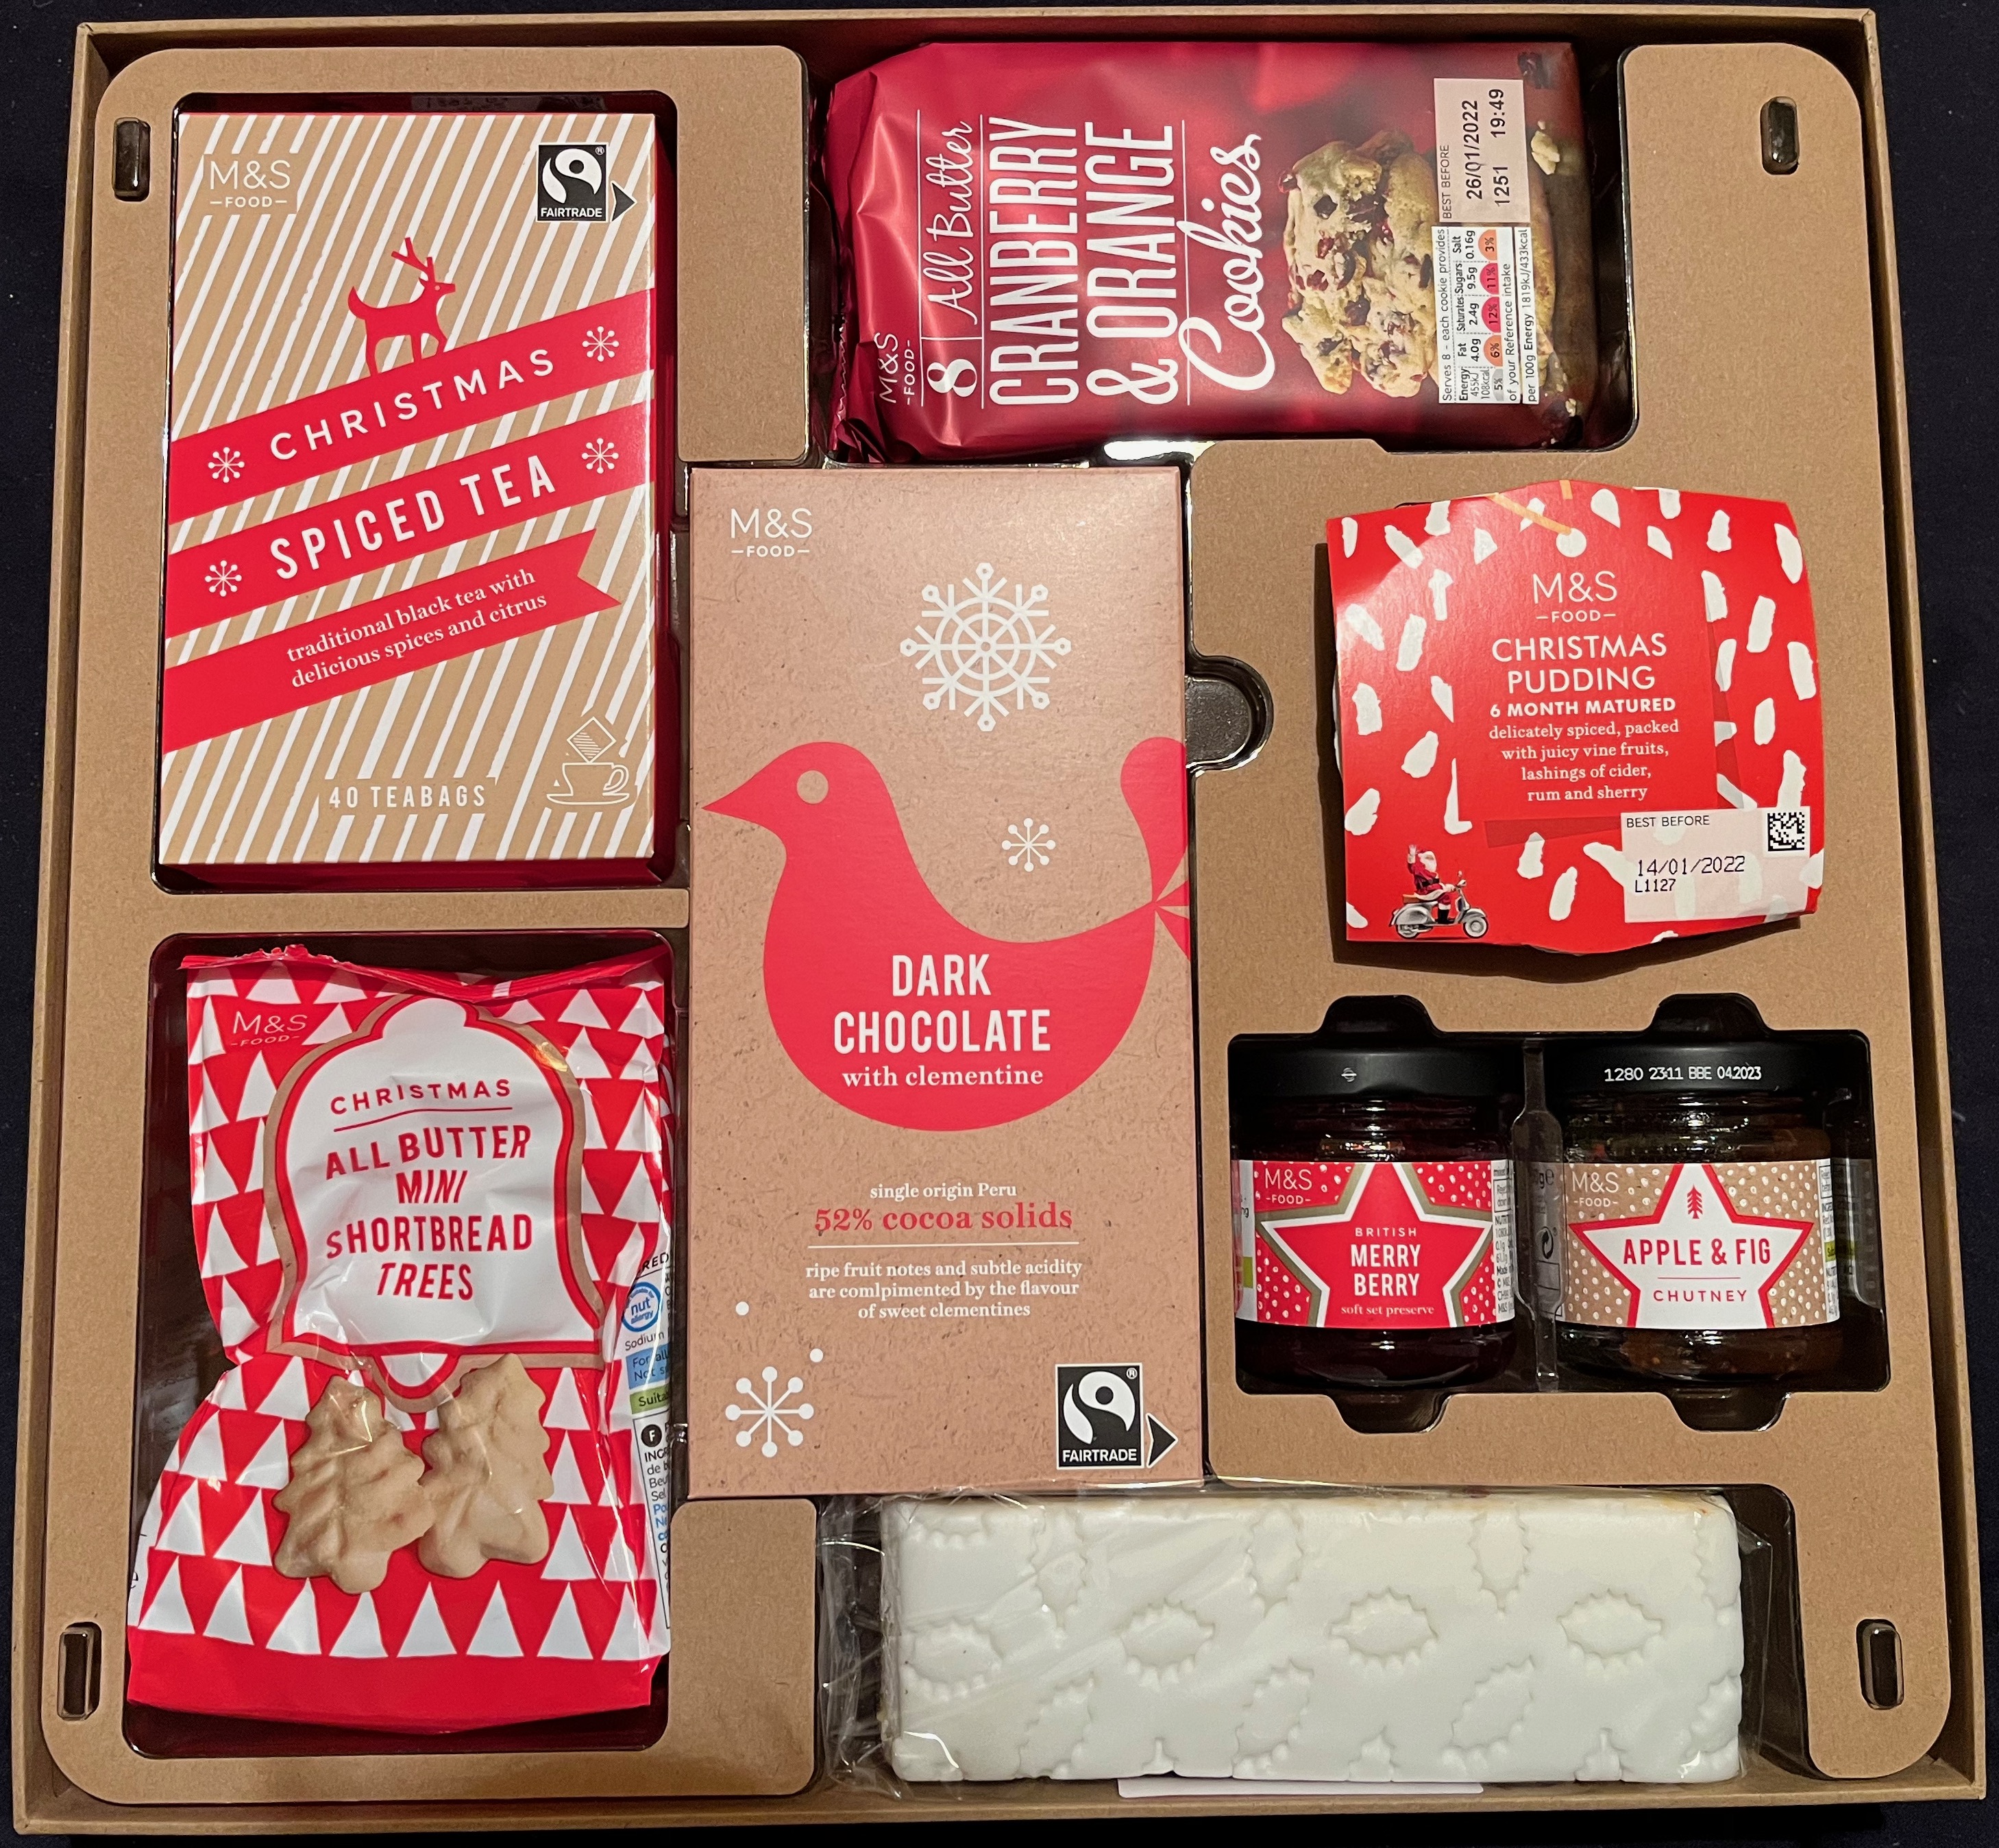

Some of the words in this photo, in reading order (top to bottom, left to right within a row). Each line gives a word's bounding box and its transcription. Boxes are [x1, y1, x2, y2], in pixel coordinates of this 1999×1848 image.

[1488, 88, 1506, 138] 19:49
[1462, 100, 1482, 199] 26/01/2022
[210, 159, 291, 190] M&S
[1440, 145, 1451, 188] BEFORE
[925, 121, 973, 241] Butter
[1493, 167, 1510, 207] 1251
[541, 207, 602, 218] FAIRTRADE
[1442, 193, 1451, 219] BEST
[1085, 121, 1177, 338] ORANGE
[1436, 229, 1449, 273] provides
[1451, 236, 1462, 254] Salt
[1464, 230, 1475, 259] 0.16g
[1484, 237, 1495, 252] 3%
[989, 116, 1079, 405] CRANBERRY
[1176, 134, 1276, 390] Cookies
[1517, 229, 1532, 308] 1819kJ/433kcal
[923, 246, 977, 325] All
[1454, 263, 1465, 294] Sugars
[1467, 267, 1477, 290] 9.5g
[1486, 267, 1496, 288] 11%
[1501, 263, 1512, 297] intake
[1438, 278, 1449, 312] cookie
[1456, 297, 1465, 332] Saturates
[1469, 303, 1479, 325] 2.4g
[1488, 304, 1499, 325] 12%
[1439, 315, 1450, 341] each
[1504, 300, 1515, 356] Reference
[1523, 313, 1534, 350] Energy
[1458, 343, 1467, 357] Fat
[1471, 338, 1481, 362] 4.0g
[1490, 343, 1500, 358] 6%
[879, 332, 898, 404] M&S
[927, 358, 978, 397] 8
[1509, 359, 1519, 386] your
[1525, 355, 1536, 380] 100g
[1086, 358, 1178, 405] &
[1443, 365, 1452, 402] Serves
[1459, 368, 1471, 401] Energy
[1470, 372, 1479, 397] 455kJ
[1480, 369, 1491, 399] 108kcal
[1494, 378, 1504, 391] 5%
[1527, 384, 1537, 403] per
[271, 349, 554, 460] CHRISTMAS
[1507, 389, 1517, 402] of
[270, 489, 445, 580] SPICED
[461, 455, 556, 516] TEA
[730, 508, 813, 539] M&S
[1532, 570, 1617, 604] M&S
[286, 613, 394, 661] traditional
[395, 596, 452, 625] black
[455, 586, 487, 607] tea
[489, 568, 536, 595] with
[291, 647, 381, 688] delicious
[385, 626, 444, 660] spices
[449, 611, 487, 637] and
[489, 593, 548, 623] citrus
[1491, 632, 1667, 663] CHRISTMAS
[1508, 665, 1656, 694] PUDDING
[1490, 704, 1501, 718] 6
[1507, 701, 1578, 717] MONTH
[1585, 698, 1676, 715] MATURED
[1489, 724, 1562, 740] delicately
[1567, 722, 1621, 739] spiced,
[1625, 719, 1680, 737] packed
[1501, 746, 1537, 760] with
[1540, 745, 1579, 762] juicy
[1582, 743, 1617, 757] vine
[1620, 743, 1669, 758] fruits,
[1521, 766, 1586, 782] lashings
[1590, 764, 1606, 778] of
[1609, 764, 1652, 778] cider,
[329, 787, 358, 809] 40
[371, 785, 485, 808] TEABAGS
[1528, 790, 1560, 802] rum
[1565, 786, 1593, 800] and
[1597, 785, 1648, 801] sherry
[1626, 817, 1656, 828] BEST
[1661, 815, 1710, 827] BEFORE
[1638, 855, 1745, 877] 14/01/2022
[1634, 878, 1676, 893] L1127
[892, 954, 991, 997] DARK
[233, 1011, 308, 1035] M&S
[834, 1009, 1050, 1054] CHOCOLATE
[842, 1065, 898, 1087] with
[905, 1065, 1044, 1085] clementine
[1604, 1067, 1643, 1081] 1280
[1688, 1066, 1713, 1080] BBE
[330, 1079, 511, 1115] CHRISTMAS
[326, 1139, 389, 1179] ALL
[400, 1124, 531, 1165] BUTTER
[395, 1169, 467, 1204] MINI
[870, 1183, 919, 1202] single
[922, 1183, 973, 1201] origin
[978, 1183, 1017, 1196] Peru
[1264, 1169, 1313, 1190] M&S
[1573, 1172, 1619, 1193] M&S
[814, 1208, 872, 1231] 52%
[883, 1211, 972, 1230] cocoa
[981, 1201, 1072, 1229] solids
[326, 1213, 532, 1259] SHORTBREAD
[1355, 1227, 1417, 1237] BRITISH
[641, 1252, 670, 1271] RED
[1350, 1243, 1421, 1268] MERRY
[1623, 1239, 1701, 1266] APPLE
[1711, 1237, 1728, 1266] &
[1736, 1239, 1771, 1265] FIG
[376, 1264, 474, 1301] TREES
[805, 1263, 839, 1281] ripe
[844, 1261, 882, 1277] fruit
[885, 1261, 931, 1277] notes
[935, 1260, 966, 1275] and
[970, 1259, 1021, 1275] subtle
[1025, 1259, 1083, 1277] acidity
[809, 1286, 835, 1299] are
[839, 1282, 961, 1301] comlpimented
[965, 1281, 985, 1301] by
[989, 1281, 1016, 1296] the
[1020, 1280, 1079, 1295] flavour
[1354, 1273, 1421, 1297] BERRY
[1653, 1290, 1747, 1303] CHUTNEY
[631, 1297, 651, 1316] nut
[858, 1303, 876, 1318] of
[879, 1305, 926, 1318] sweet
[929, 1302, 1031, 1316] clementines
[1341, 1303, 1364, 1315] soft
[1366, 1305, 1383, 1315] set
[1385, 1305, 1434, 1318] preserve
[638, 1392, 669, 1407] Suita
[1062, 1449, 1137, 1462] FAIRTRADE
